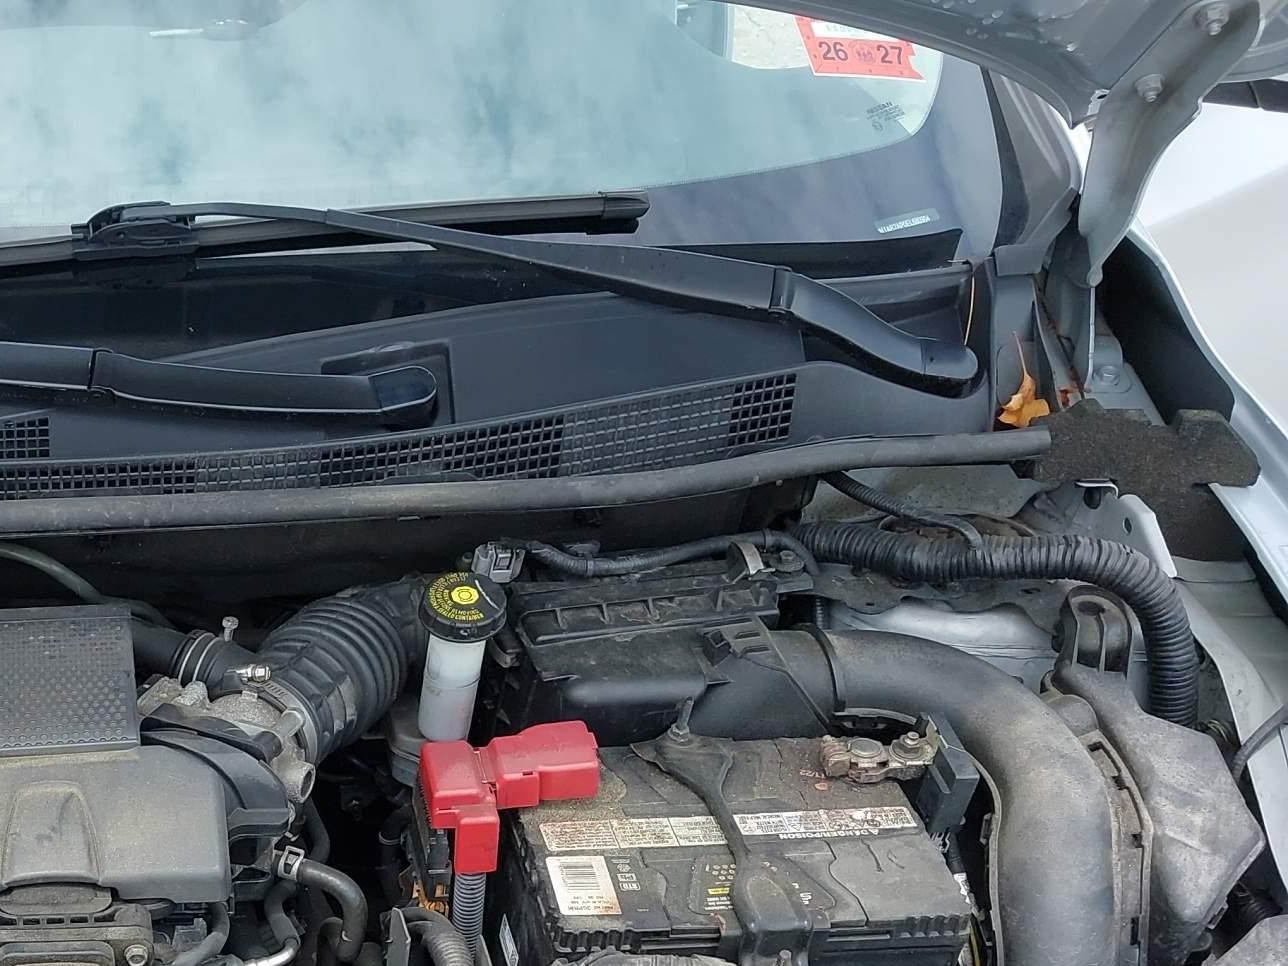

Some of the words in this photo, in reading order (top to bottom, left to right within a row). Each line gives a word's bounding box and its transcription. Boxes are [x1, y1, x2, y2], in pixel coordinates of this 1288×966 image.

[818, 41, 849, 62] 26
[876, 44, 903, 65] 27
[778, 829, 869, 840] DANGER/POISON
